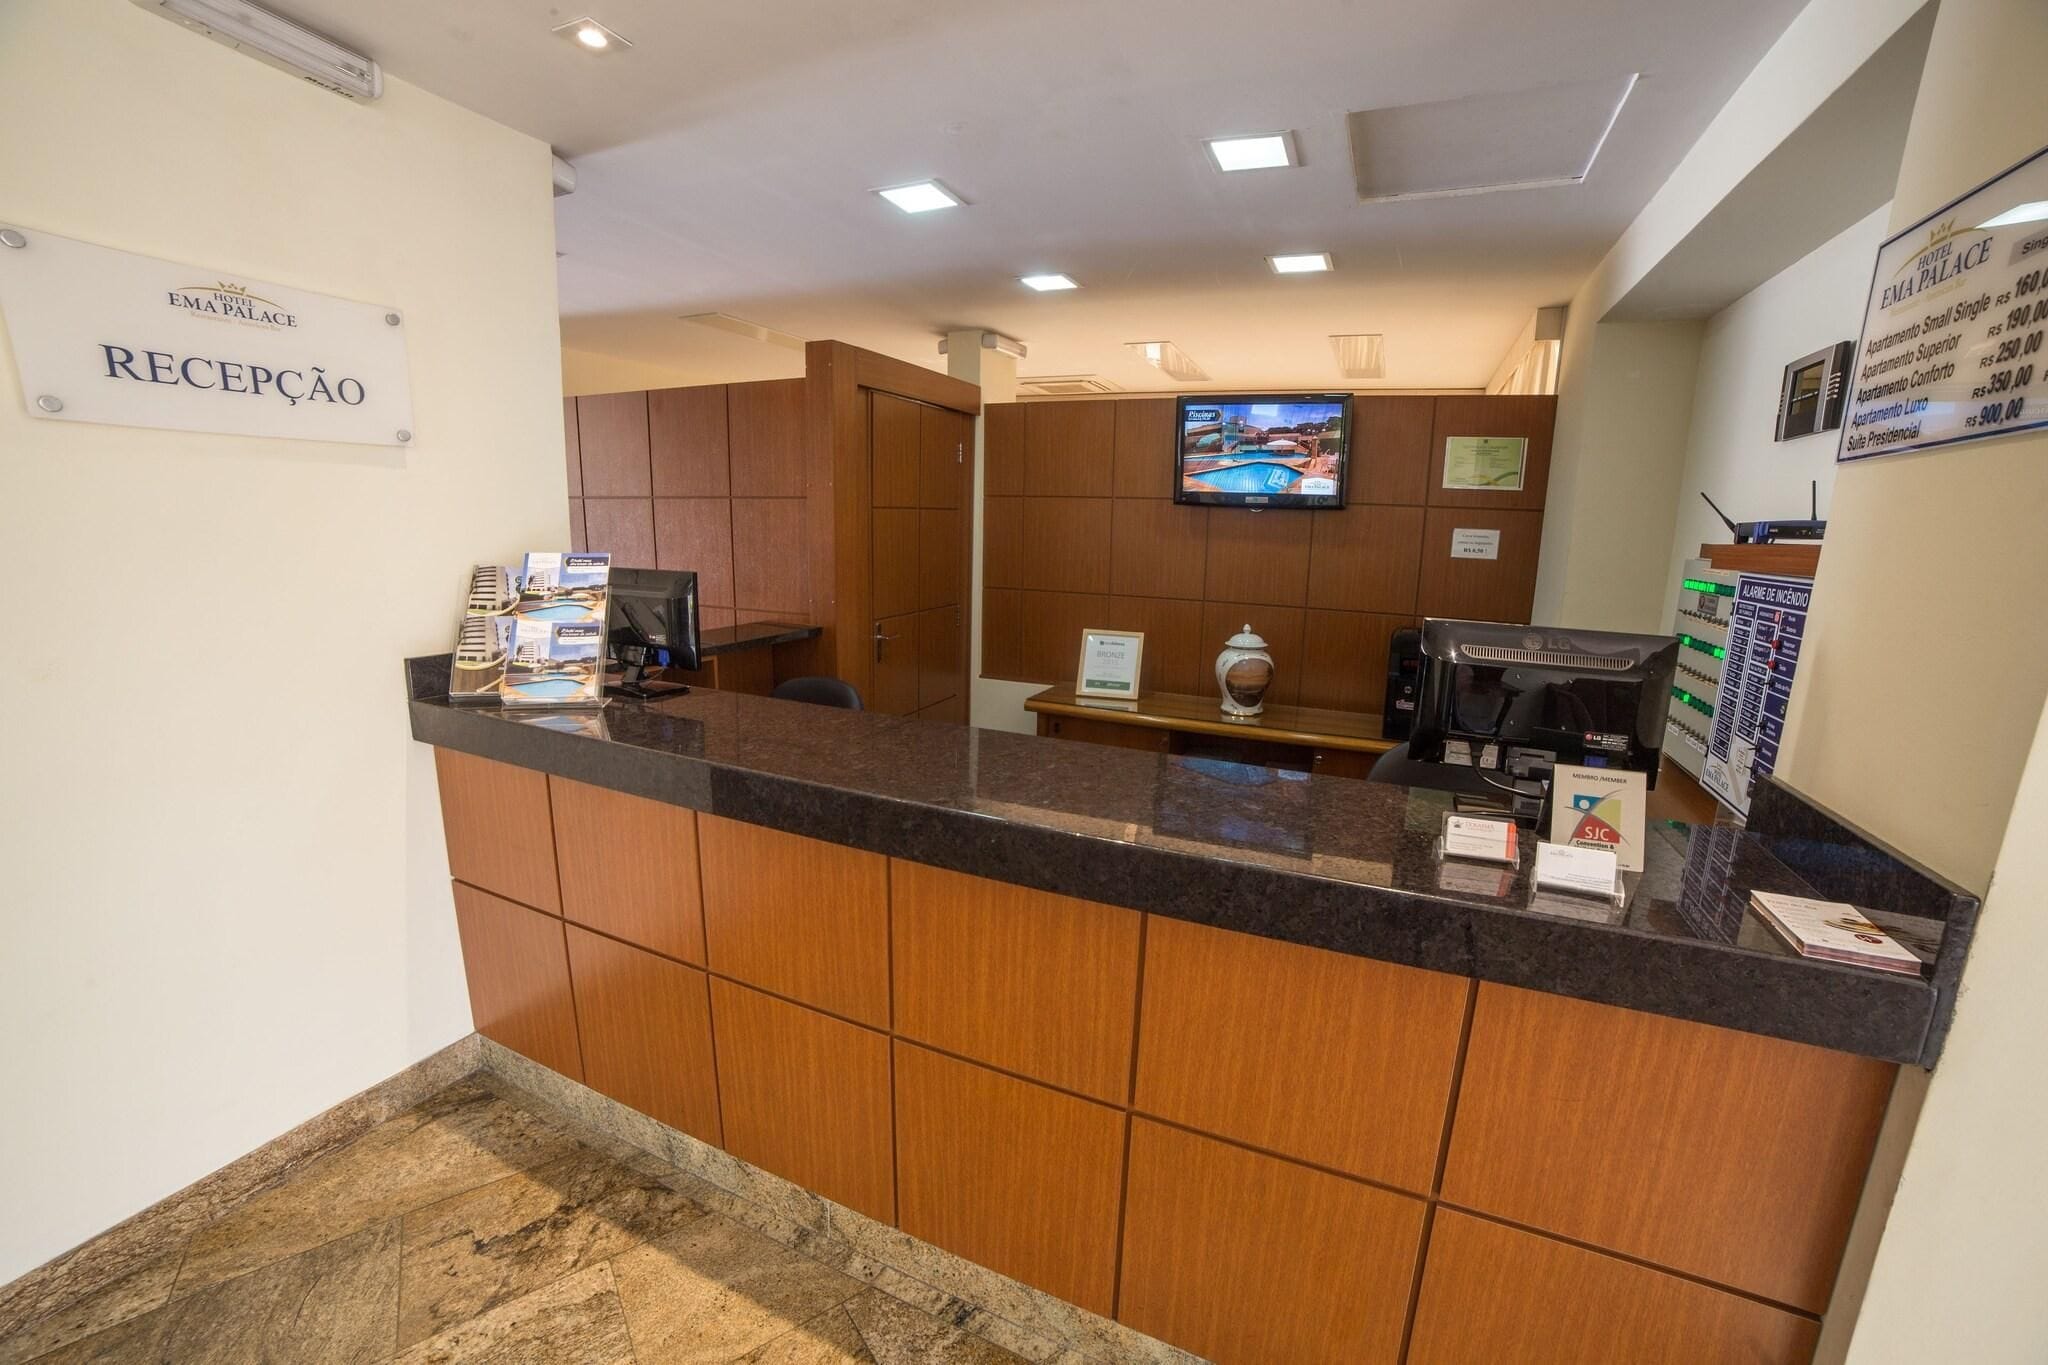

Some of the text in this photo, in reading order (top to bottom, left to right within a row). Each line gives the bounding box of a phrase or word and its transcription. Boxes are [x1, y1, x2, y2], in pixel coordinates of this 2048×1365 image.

[1880, 276, 1913, 310] EMA
[1917, 236, 1994, 293] PALACE
[1917, 242, 1953, 271] HOTEL
[168, 292, 218, 313] EMA
[222, 302, 298, 328] PALACE
[214, 293, 256, 308] HOTEL
[1865, 322, 1921, 357] Apartamento
[1922, 306, 1953, 335] Small
[1953, 292, 1991, 322] Single
[98, 343, 366, 407] RECEPÇÃO
[1856, 375, 1909, 408] Apartamento
[1910, 362, 1955, 388] Conforto
[1995, 329, 2043, 363] 250,00
[1860, 350, 1914, 382] Apartamento
[1916, 332, 1962, 363] Superior
[1851, 401, 1903, 430] Apartamento
[1904, 397, 1929, 415] Luxo
[1987, 364, 2033, 394] 350,00
[1868, 420, 1922, 448] Presidencial
[1978, 397, 2025, 427] 900,00
[1742, 584, 1809, 607] ALARME DE INCÊNDIO
[1548, 638, 1571, 650] LG
[1575, 839, 1609, 849] Convention
[1585, 826, 1610, 841] SJC
